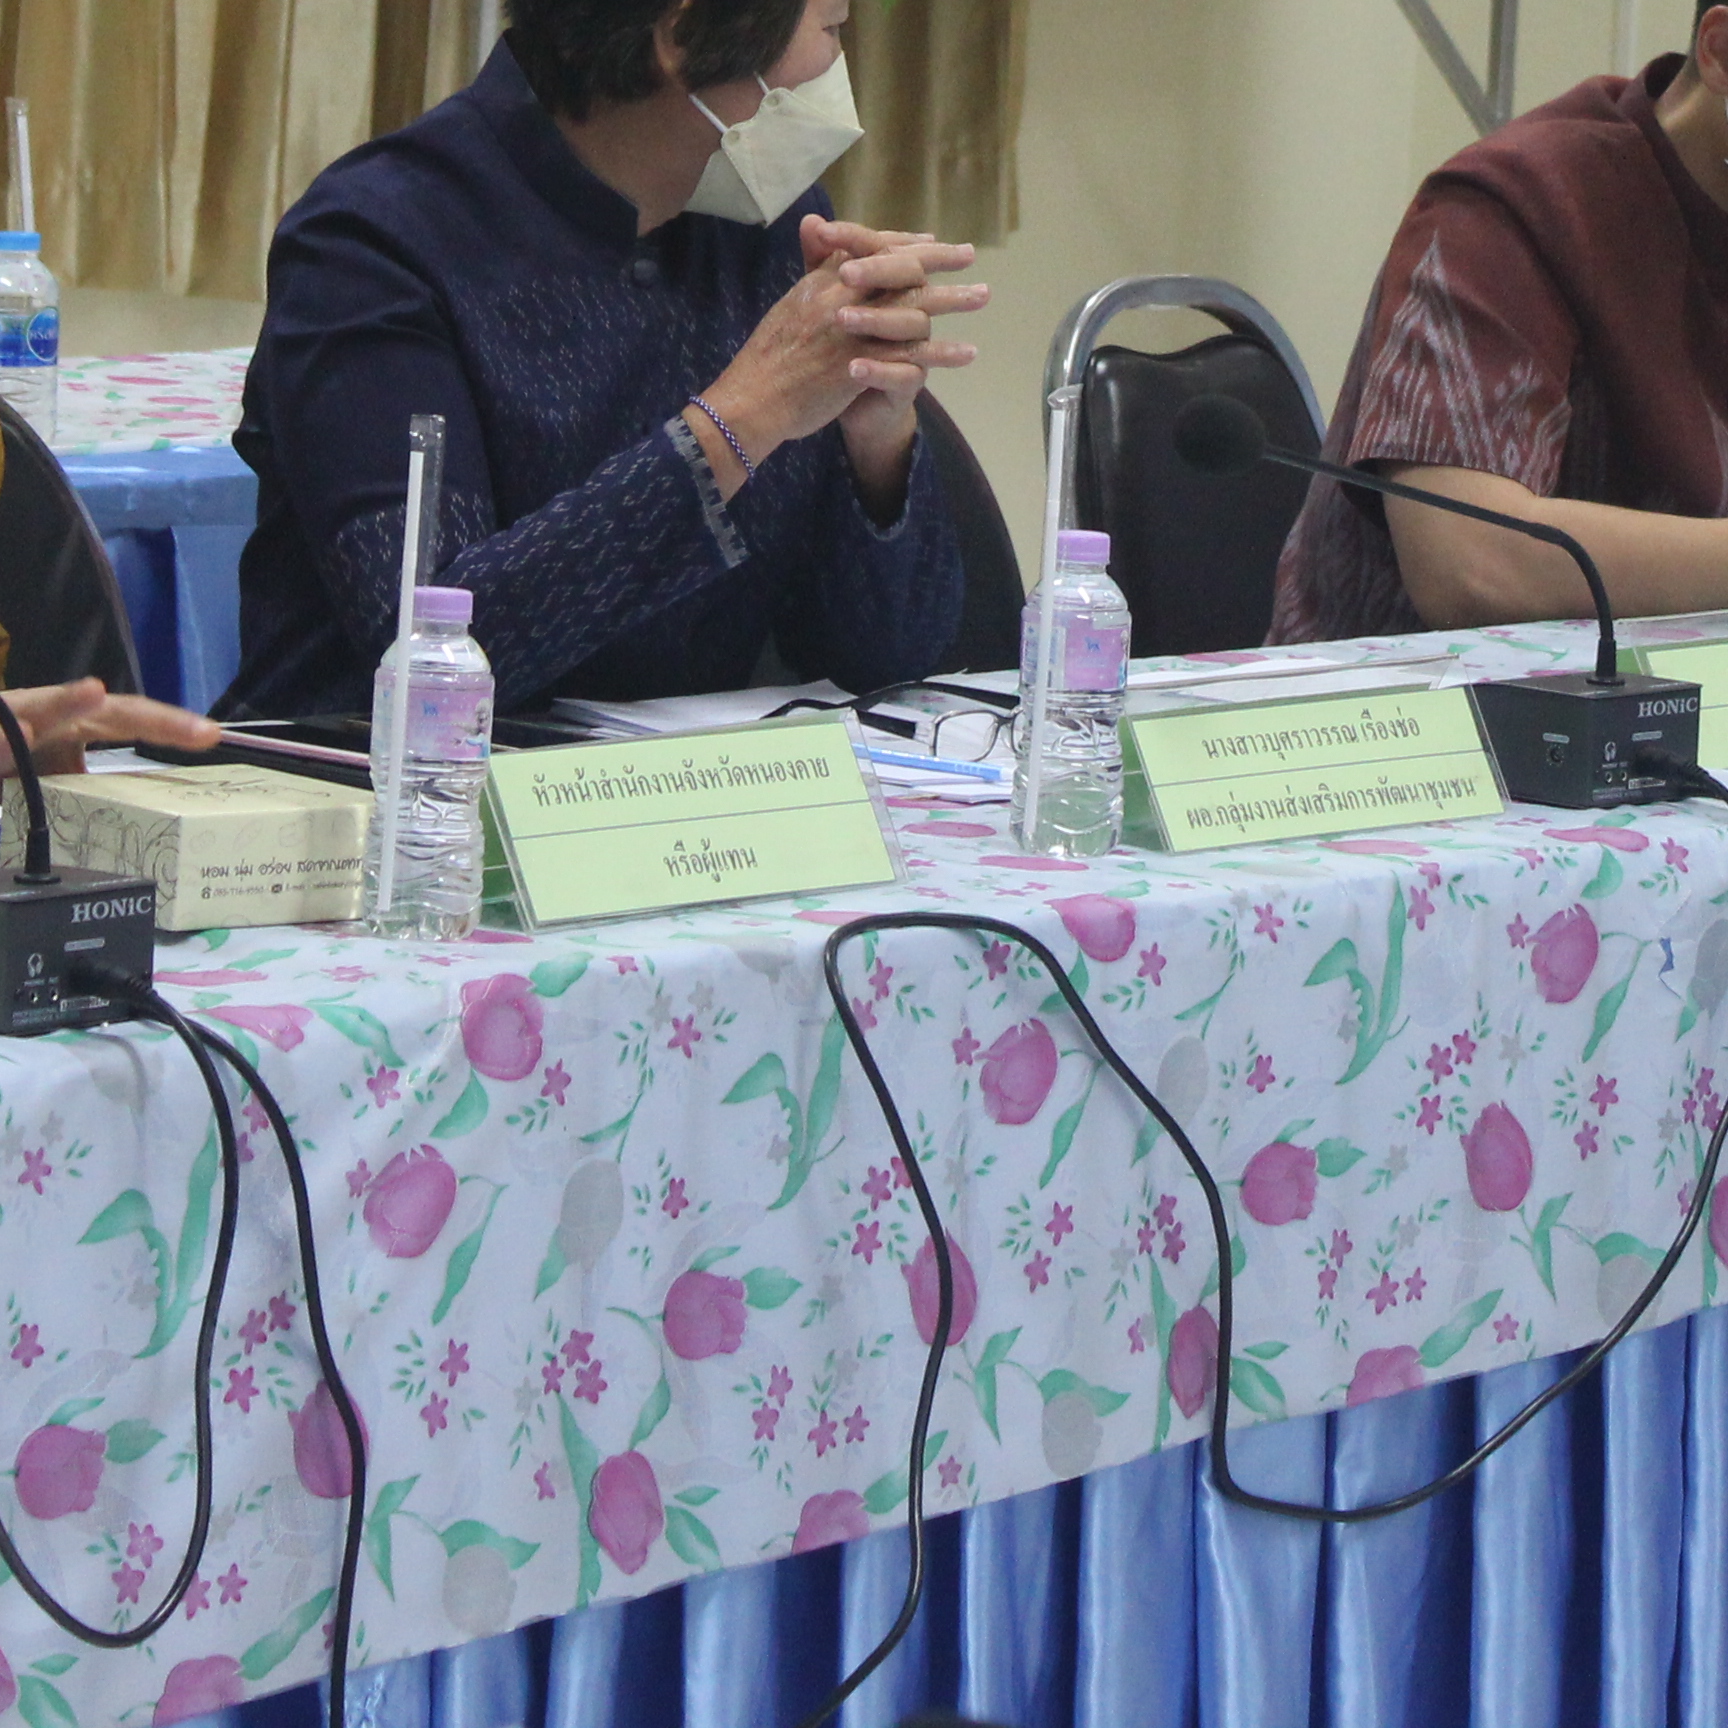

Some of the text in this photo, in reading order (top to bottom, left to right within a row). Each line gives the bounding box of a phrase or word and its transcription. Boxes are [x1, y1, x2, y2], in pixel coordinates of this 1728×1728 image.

[531, 755, 831, 808] หัวหน้าสำนักงานจังหวัดหนองคาย
[663, 838, 757, 883] หรือผู้แทน
